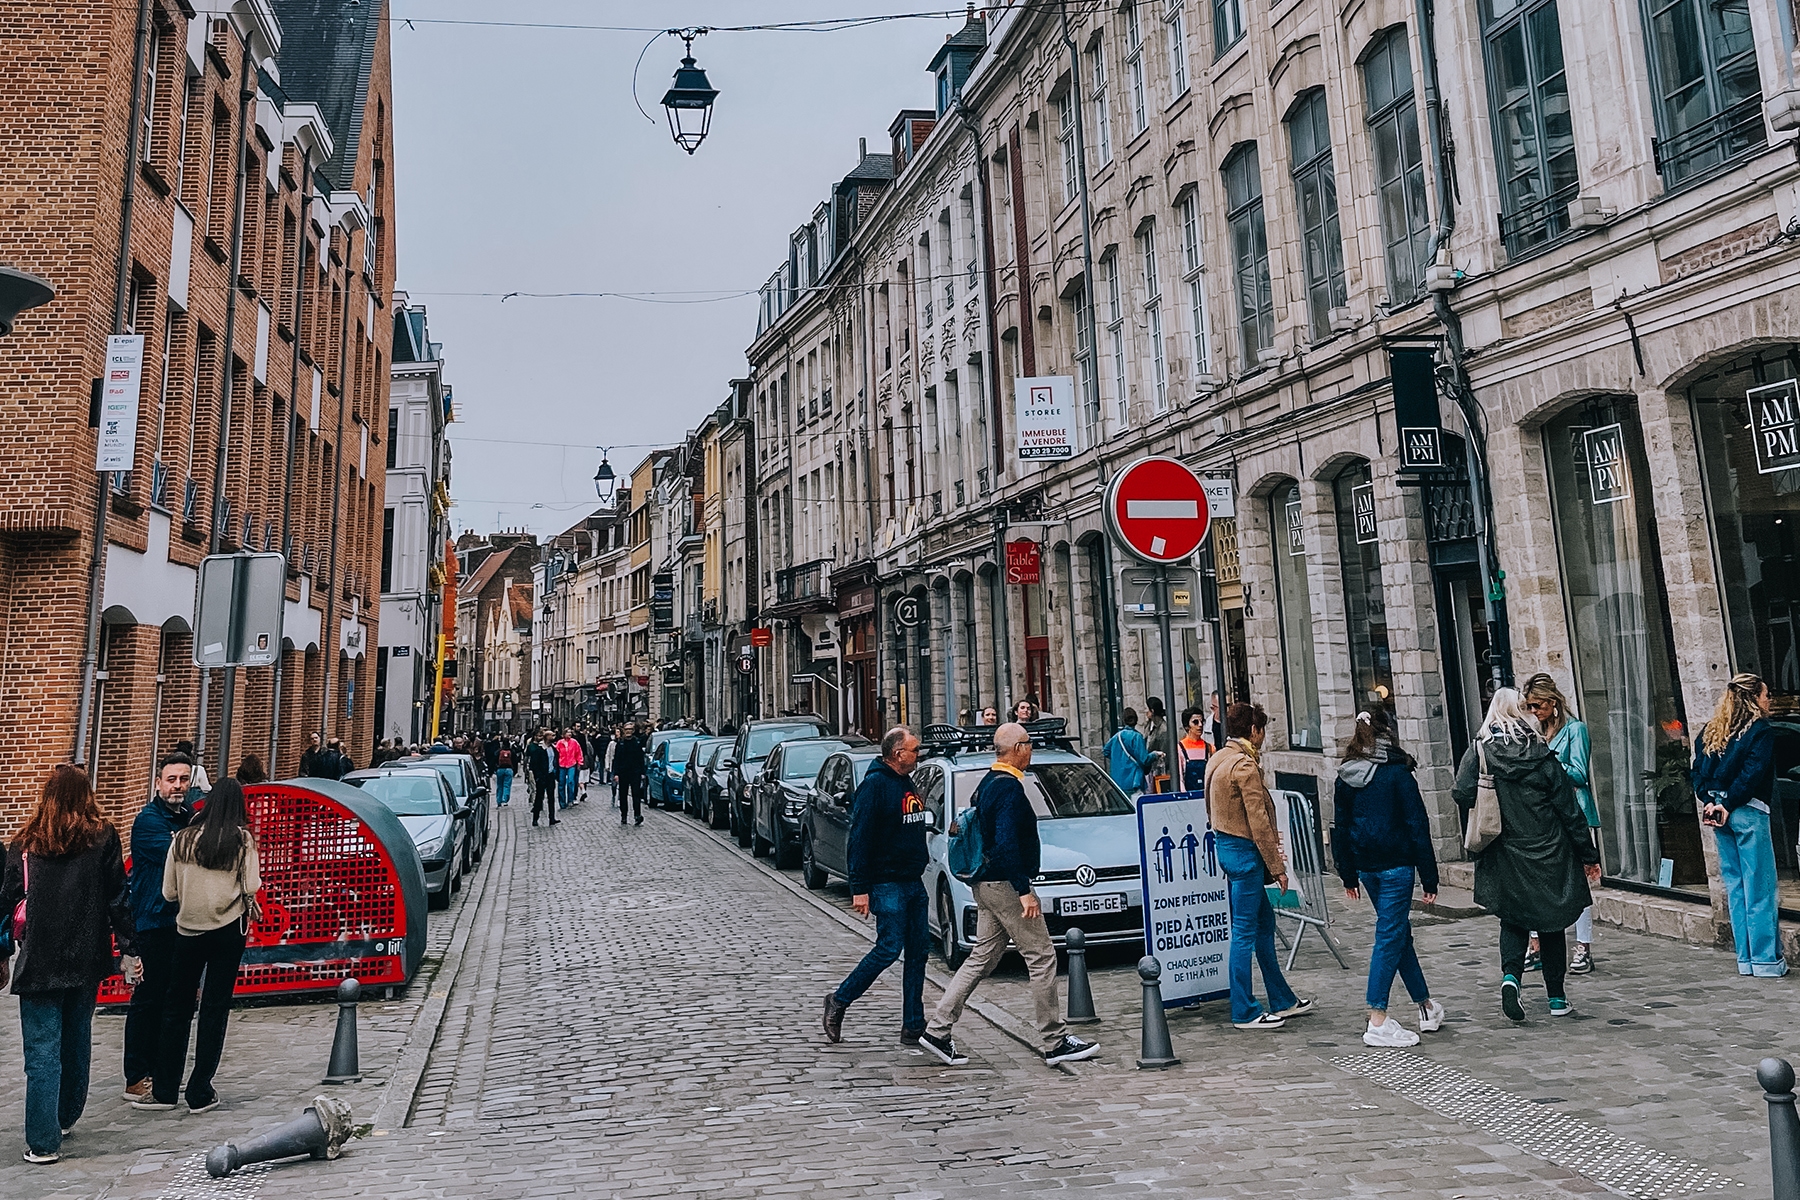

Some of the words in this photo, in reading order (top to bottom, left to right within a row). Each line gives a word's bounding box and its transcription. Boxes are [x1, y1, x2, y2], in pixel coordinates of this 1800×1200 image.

[1760, 395, 1794, 428] AM
[1021, 428, 1067, 438] IMMEUBLE
[1031, 437, 1067, 446] VENDRE
[1410, 433, 1433, 446] AM
[1052, 446, 1070, 454] 7000
[1594, 437, 1618, 464] AM
[1763, 427, 1799, 458] PM
[1412, 448, 1435, 460] PM
[1596, 465, 1621, 491] PM
[1358, 493, 1373, 514] AM
[1359, 514, 1375, 534] PM
[1008, 544, 1017, 552] La
[1007, 552, 1034, 566] Table
[1009, 566, 1039, 584] Siam
[742, 659, 751, 670] B
[1062, 897, 1119, 913] GB-516-GE
[1154, 896, 1181, 910] ZONE
[1182, 889, 1226, 907] PIÉTONNE
[1155, 919, 1182, 936] PIED
[1185, 913, 1194, 932] À
[1194, 911, 1228, 930] TERRE
[1156, 927, 1229, 952] OBLIGATOIRE
[1166, 956, 1198, 971] CHAQUE
[1198, 952, 1223, 966] SAMEDI
[1174, 972, 1184, 983] DE
[1186, 969, 1199, 981] 11H
[1205, 966, 1219, 977] 19H
